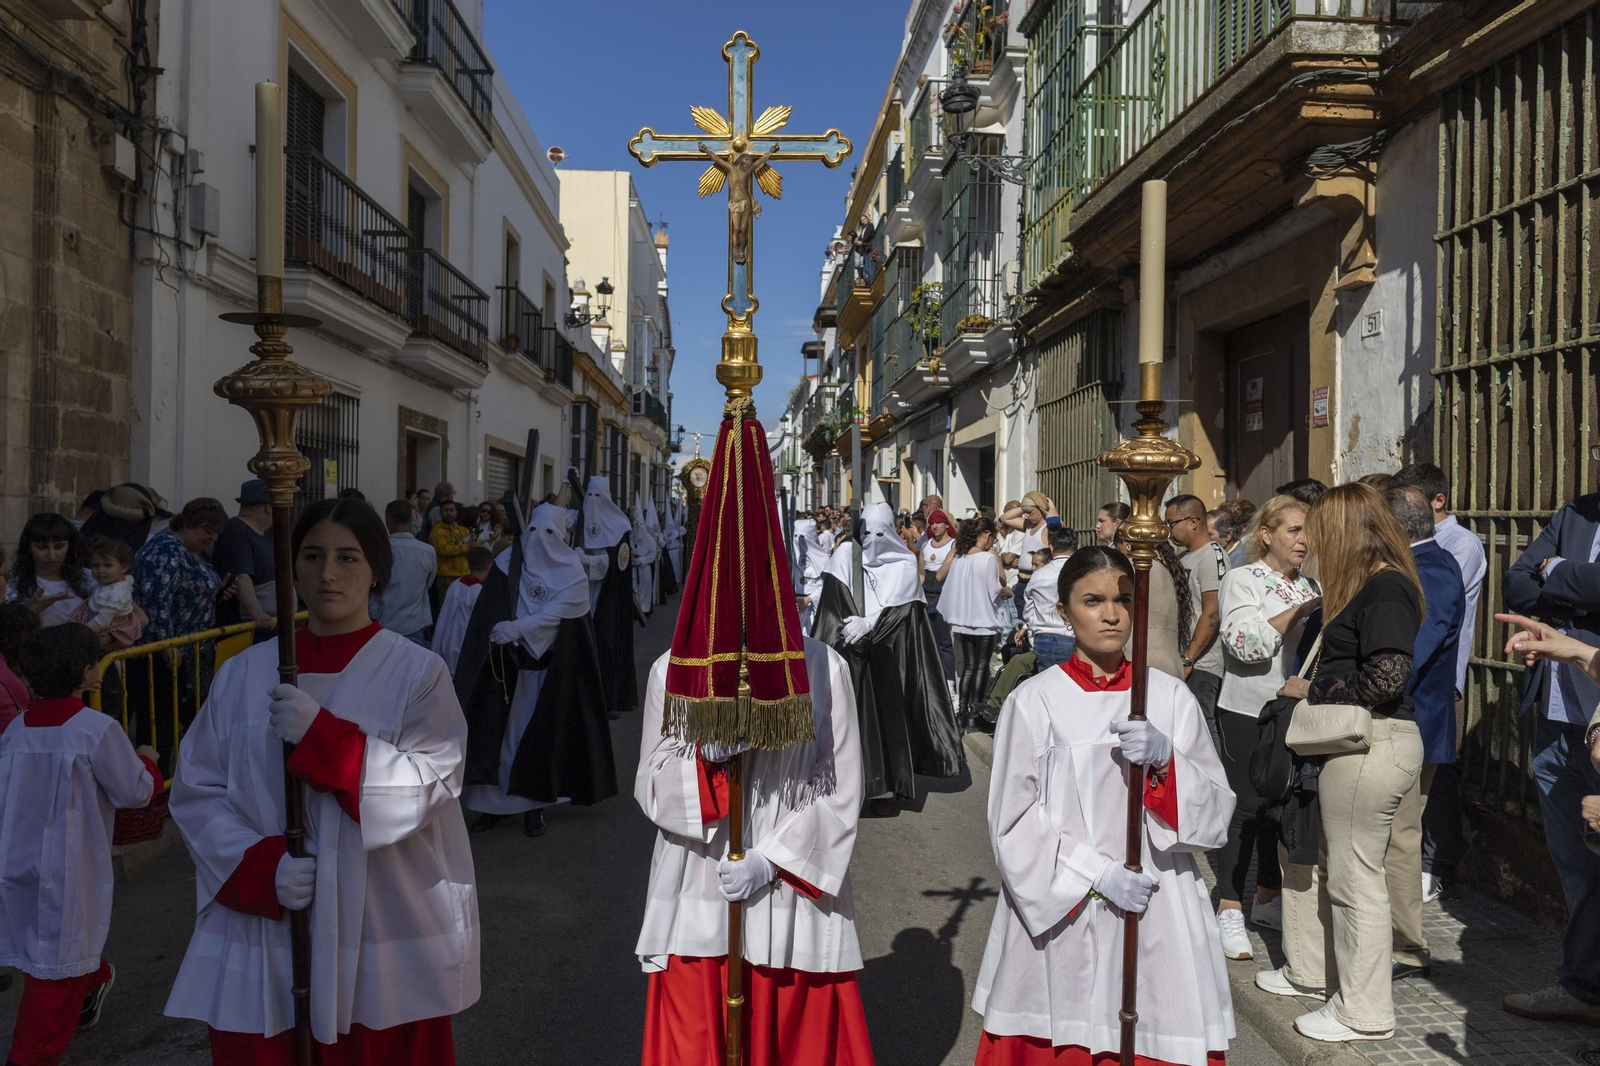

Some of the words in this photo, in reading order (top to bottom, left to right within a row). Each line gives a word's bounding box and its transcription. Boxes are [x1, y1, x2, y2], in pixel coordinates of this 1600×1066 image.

[1368, 316, 1377, 333] 51
[1297, 719, 1320, 731] TOTE
[1324, 717, 1348, 727] BAG
